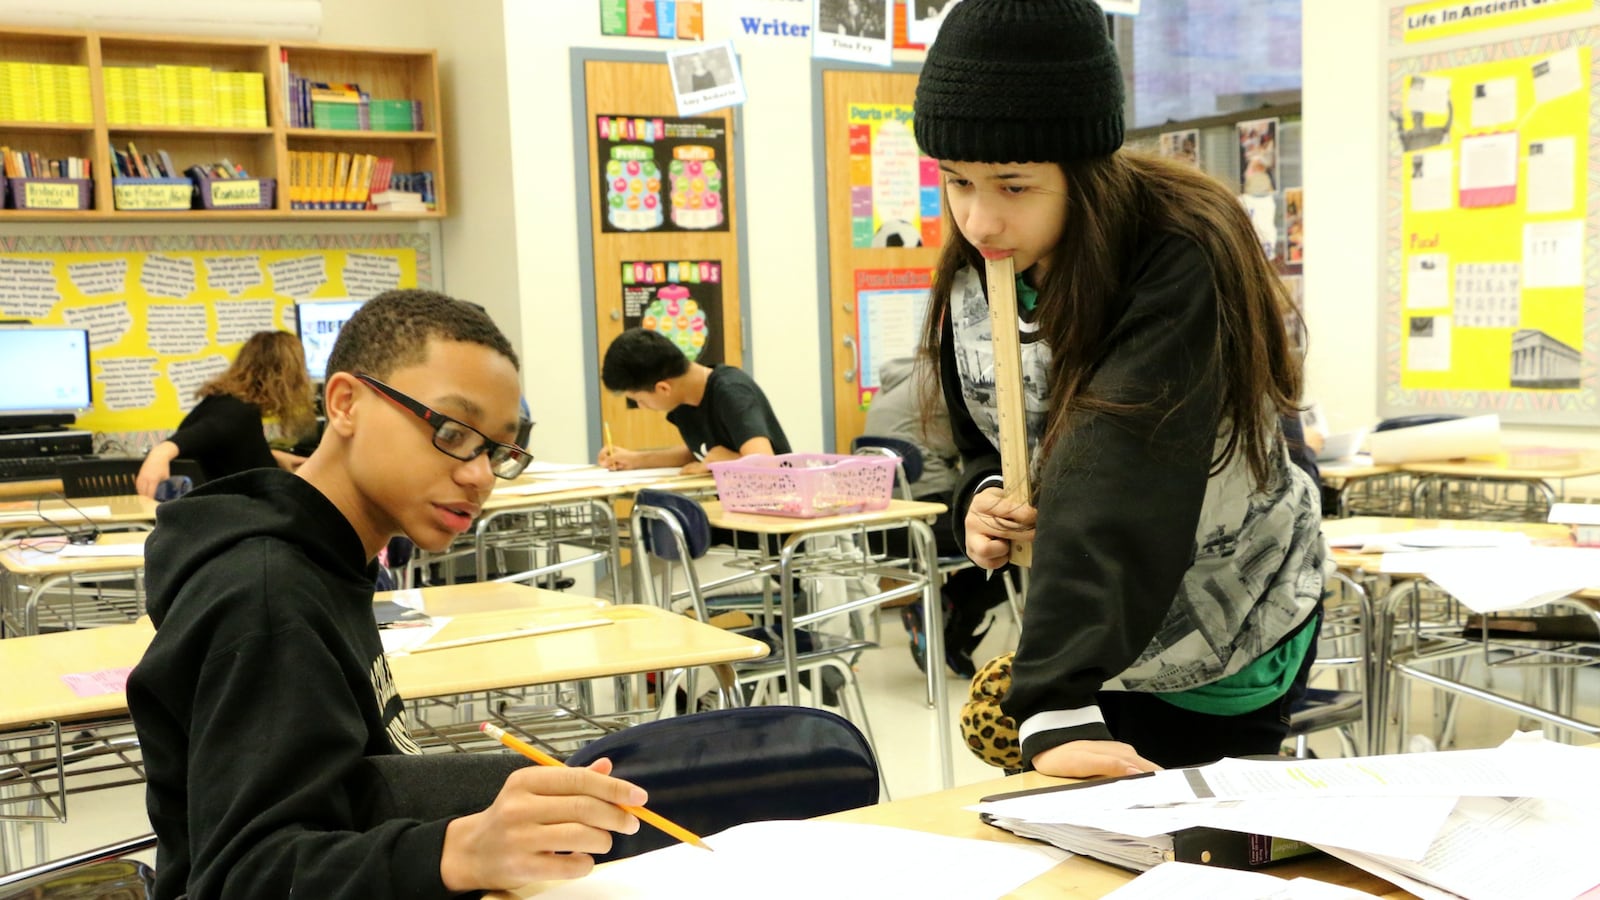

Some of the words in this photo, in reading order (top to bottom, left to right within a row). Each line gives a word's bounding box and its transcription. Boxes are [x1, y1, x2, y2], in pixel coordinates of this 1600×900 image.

[1408, 14, 1437, 30] Life
[1442, 10, 1458, 22] In
[1461, 0, 1527, 19] Ancient
[740, 17, 810, 38] Writer
[832, 39, 854, 50] Tina
[856, 43, 873, 53] Fey
[851, 106, 882, 120] Parts
[883, 111, 892, 119] of
[29, 184, 75, 197] Historical
[213, 186, 258, 200] Romance
[30, 198, 64, 207] Fiction
[624, 263, 664, 283] ROOT
[668, 262, 719, 283] WORDS
[858, 272, 929, 286] Punctuation
